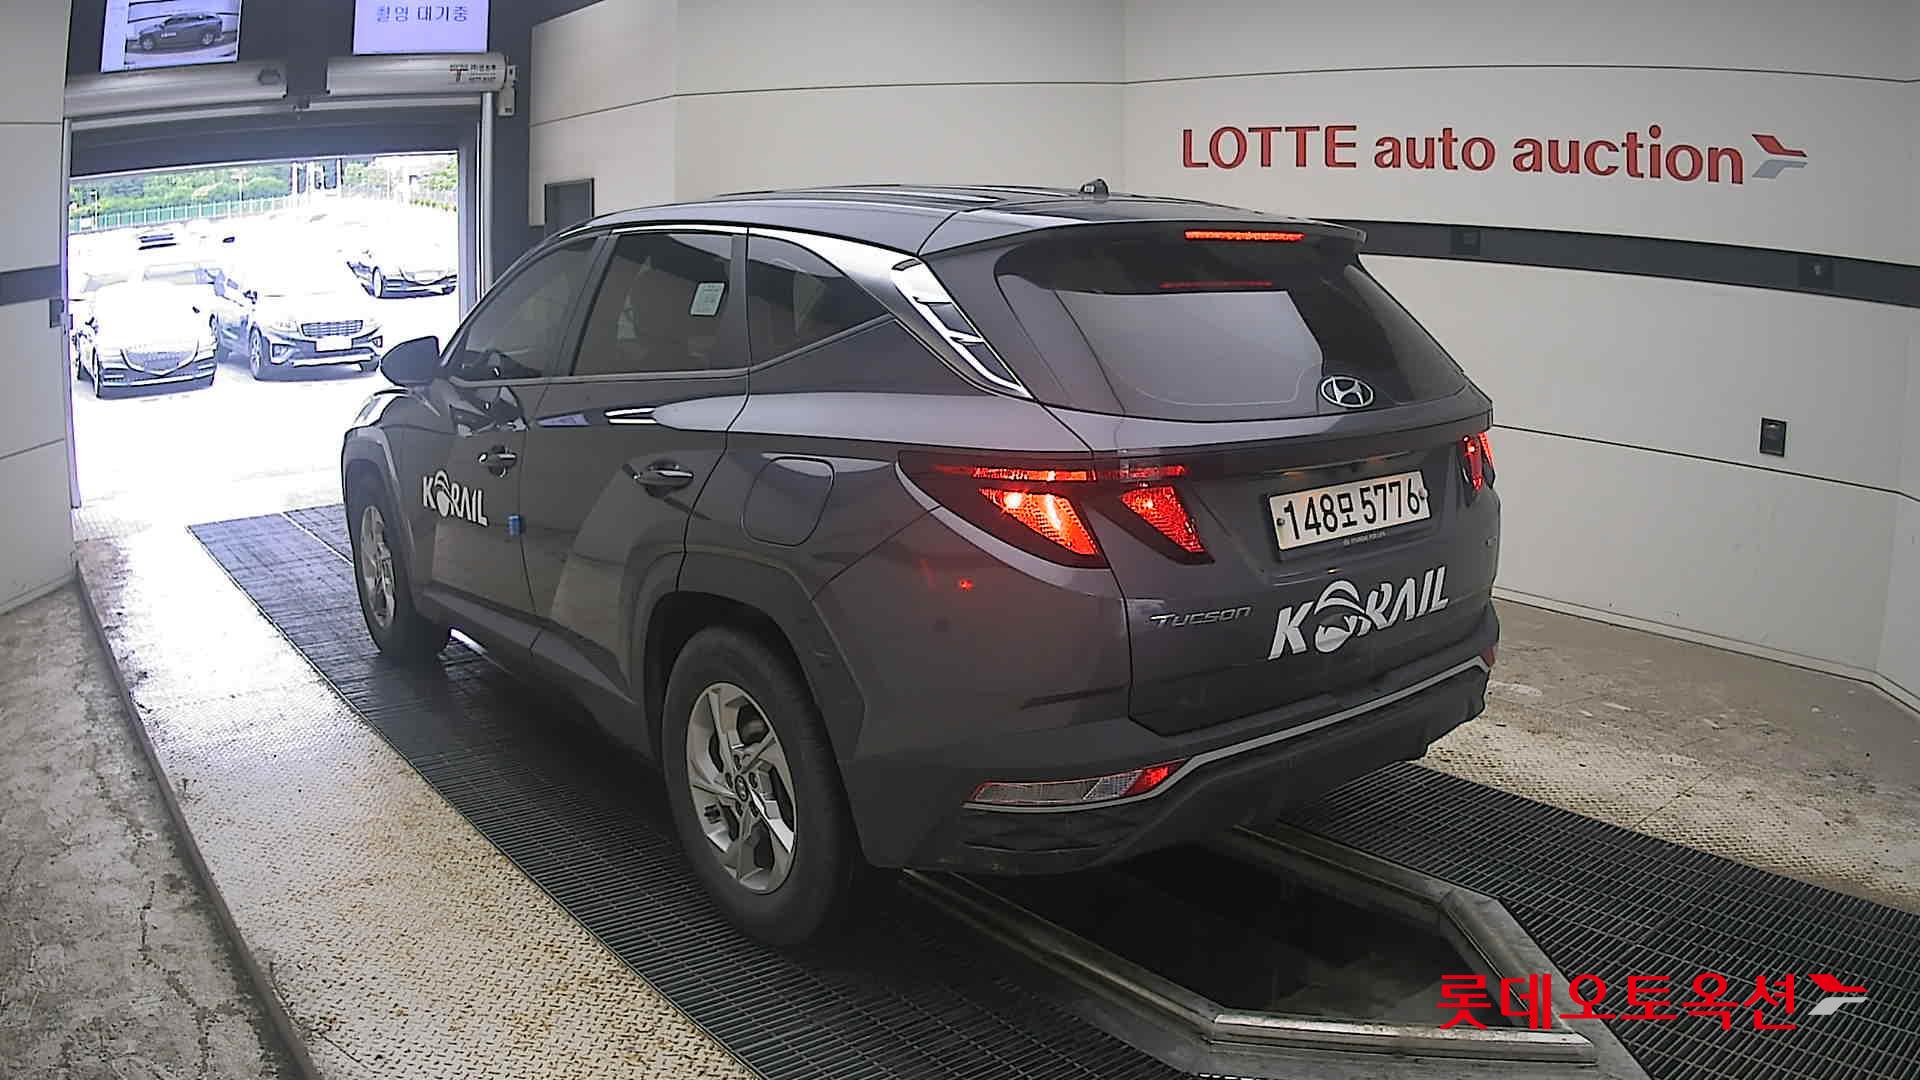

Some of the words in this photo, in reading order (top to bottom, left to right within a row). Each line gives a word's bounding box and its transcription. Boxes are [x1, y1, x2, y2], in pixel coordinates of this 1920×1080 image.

[417, 5, 468, 22] 대기중
[1183, 125, 1358, 169] LOTTE
[1373, 127, 1495, 171] auto
[1512, 124, 1744, 186] auction
[422, 470, 488, 527] KORAIL
[1267, 565, 1449, 661] KORAIL
